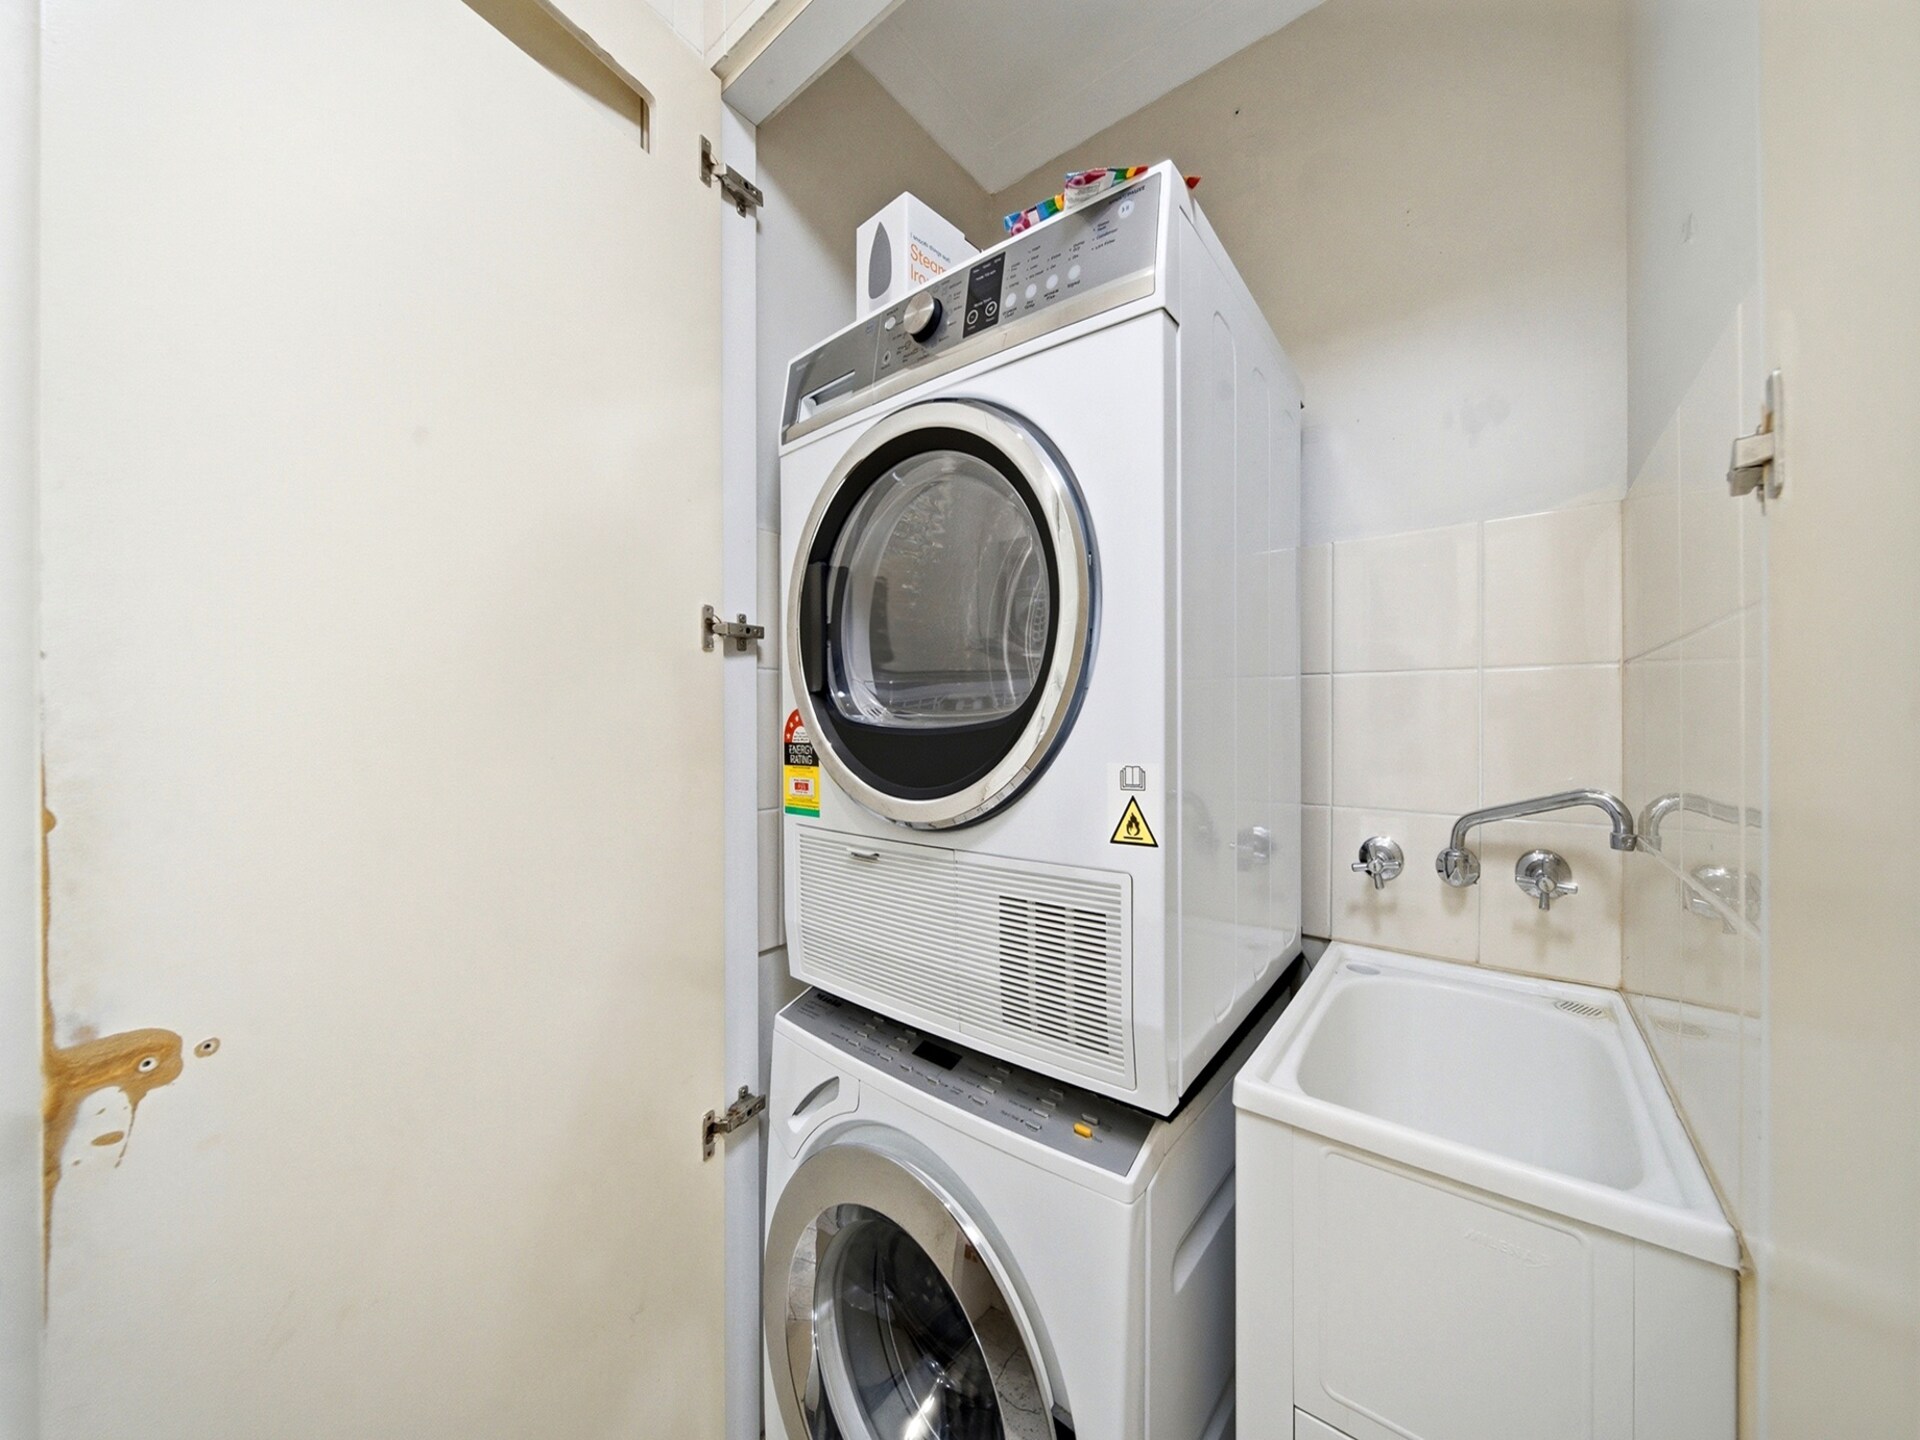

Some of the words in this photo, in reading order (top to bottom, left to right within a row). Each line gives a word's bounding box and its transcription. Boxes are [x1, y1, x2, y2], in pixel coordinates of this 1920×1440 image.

[910, 263, 929, 285] Iro
[788, 743, 813, 755] ENERGY
[789, 754, 813, 765] RATING
